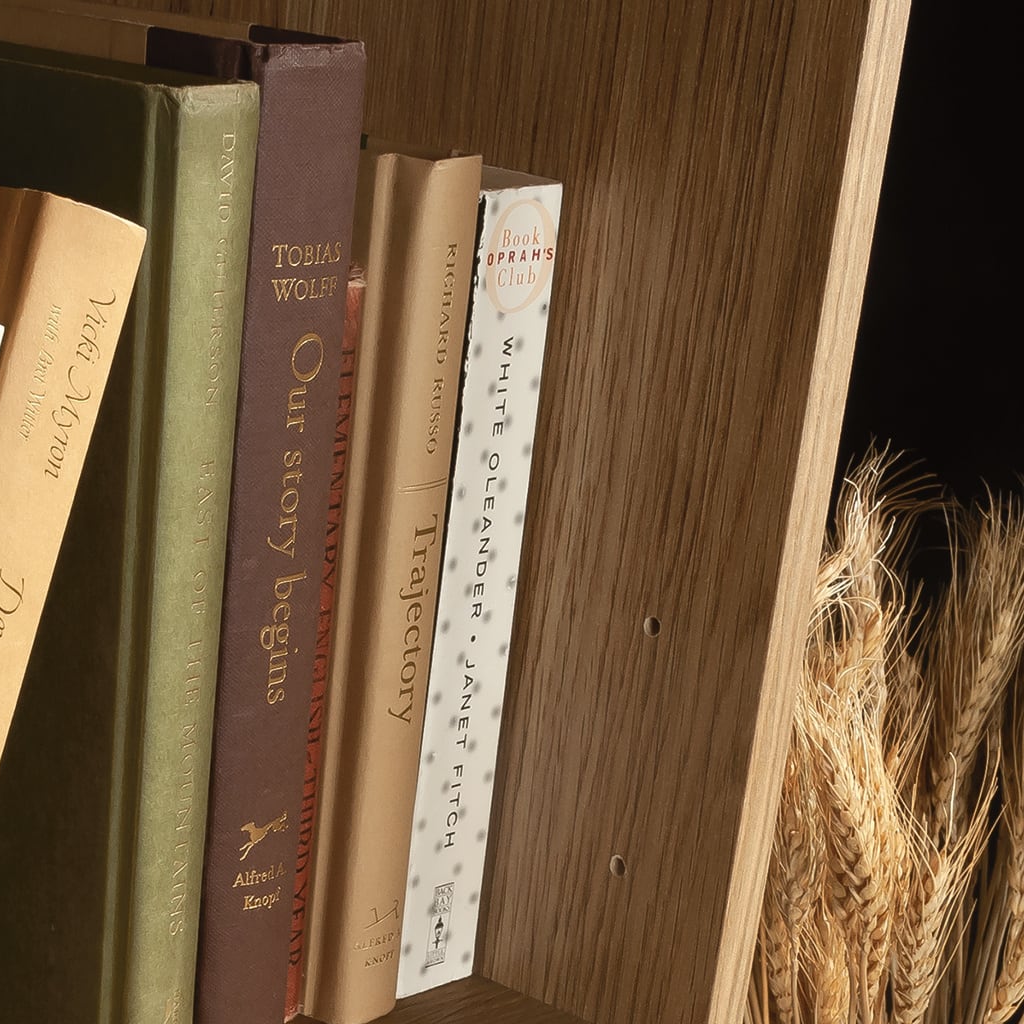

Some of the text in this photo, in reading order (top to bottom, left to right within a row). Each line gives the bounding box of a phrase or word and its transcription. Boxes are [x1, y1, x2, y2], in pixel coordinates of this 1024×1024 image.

[218, 132, 236, 223] DAVID
[272, 241, 342, 268] TOBIAS
[502, 226, 540, 247] Book
[487, 247, 554, 266] OPRAH'S
[271, 276, 338, 302] WOLFF
[498, 265, 536, 287] Club
[45, 304, 61, 342] with
[426, 243, 457, 455] RICHARD RUSSO
[45, 288, 116, 479] Vicki Myron
[19, 390, 47, 441] Witter
[259, 332, 324, 705] Our story begins
[444, 336, 514, 848] WHITE OLEANDER JANET FITCH
[388, 513, 439, 725] Trajectory
[232, 865, 274, 888] Alfred
[242, 886, 281, 911] Knopf
